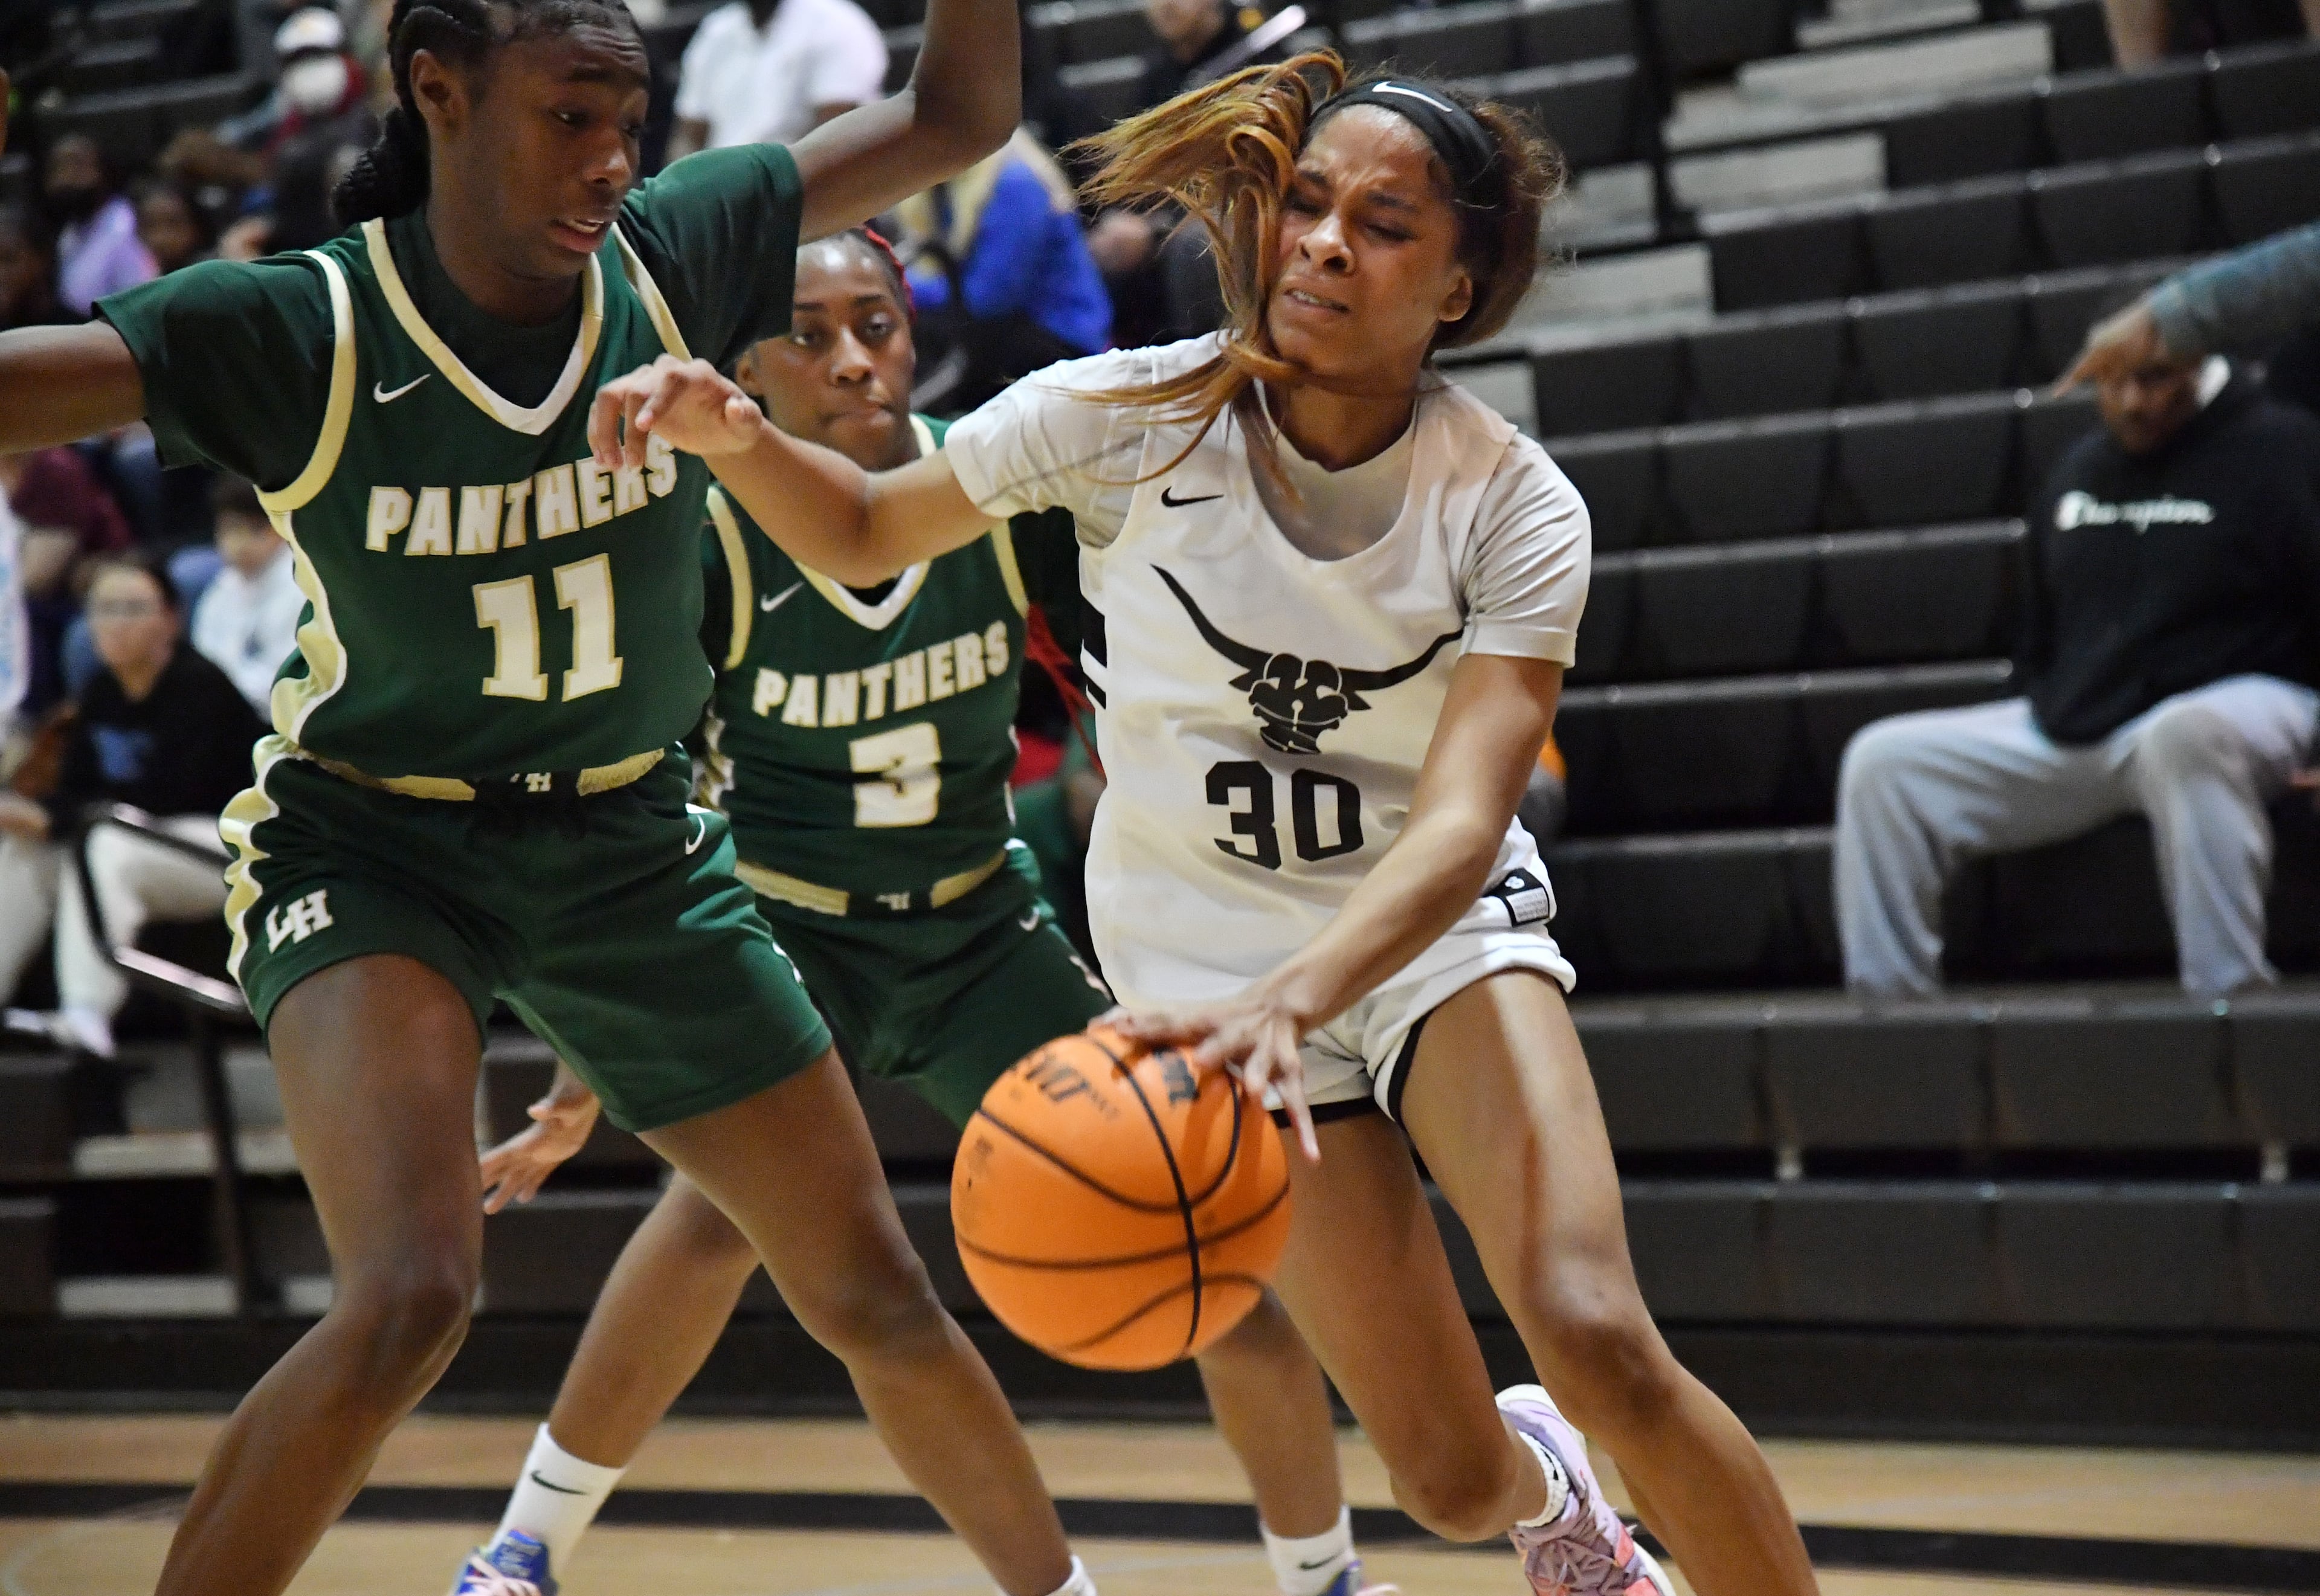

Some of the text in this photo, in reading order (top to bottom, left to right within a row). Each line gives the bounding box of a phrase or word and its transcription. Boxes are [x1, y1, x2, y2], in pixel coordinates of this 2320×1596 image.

[366, 432, 677, 556] PANTHERS
[472, 553, 624, 702] 11
[752, 620, 1010, 728] PANTHERS
[849, 722, 941, 828] 3
[1205, 760, 1364, 871] 30
[266, 889, 335, 954] LH
